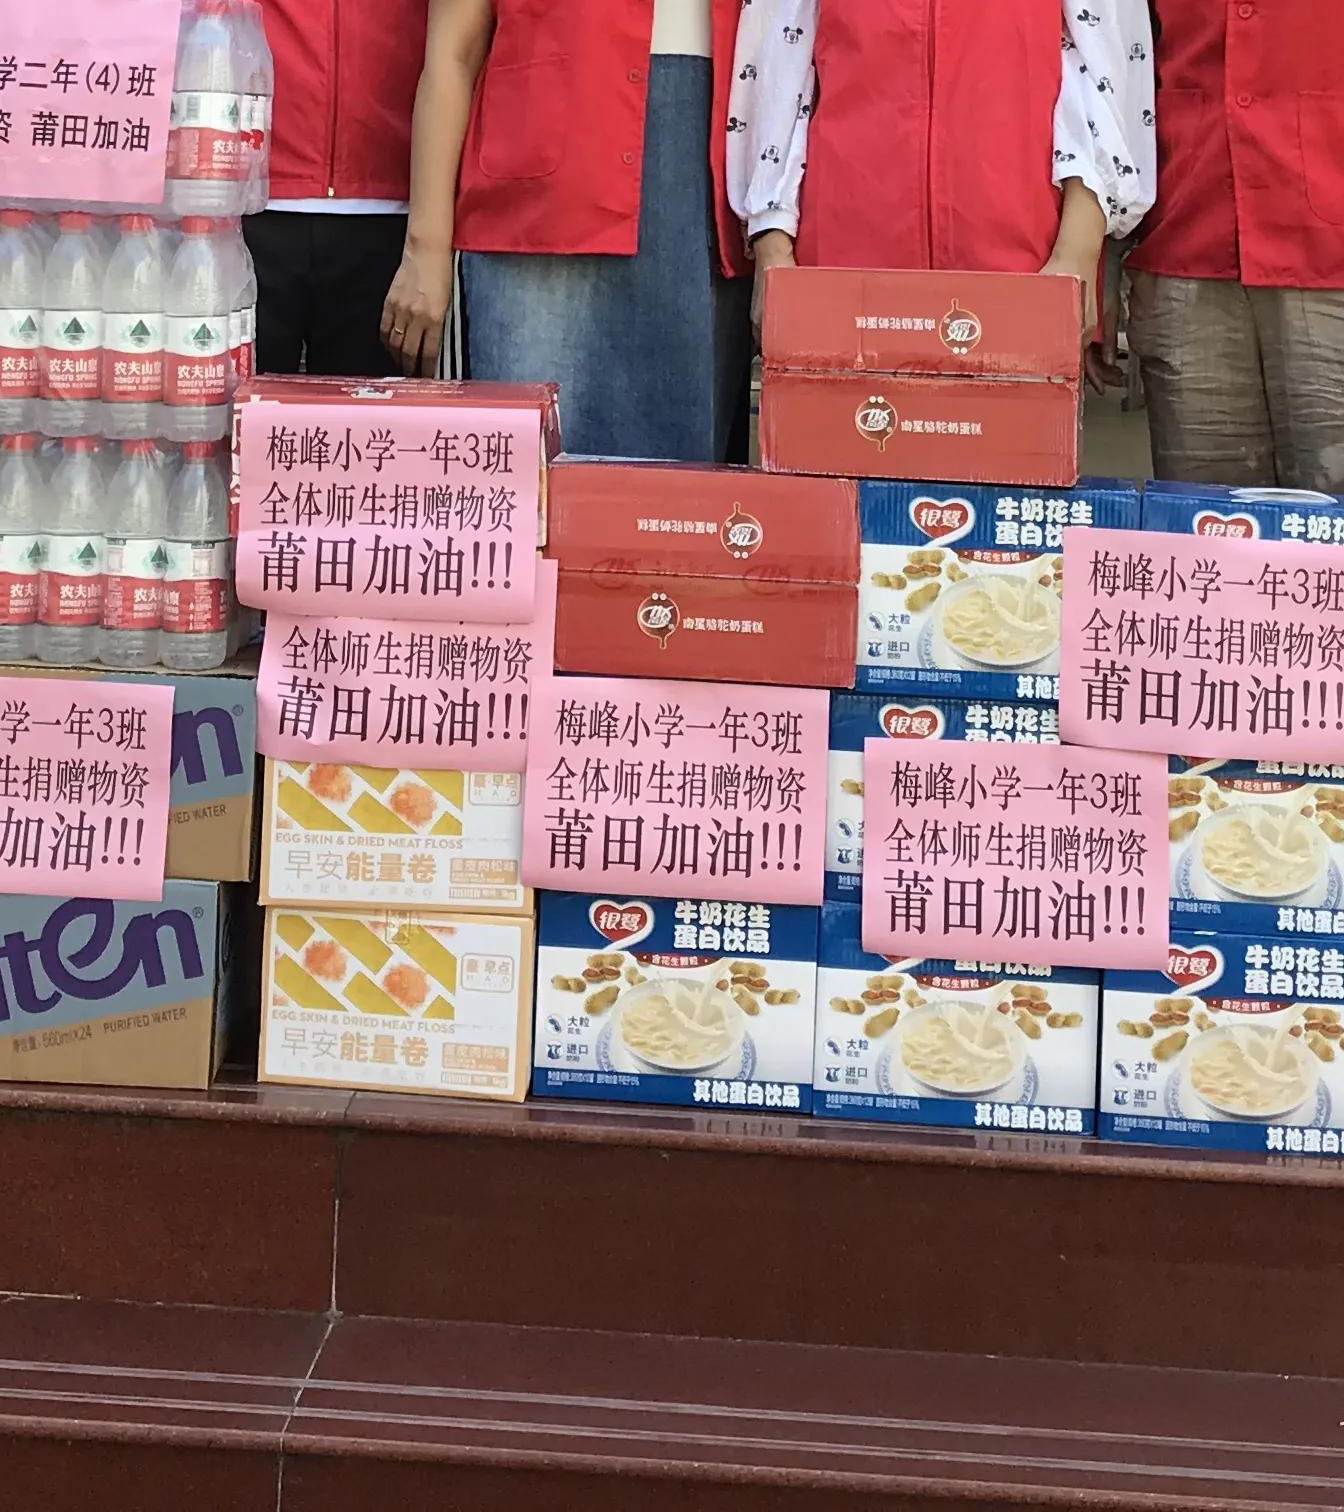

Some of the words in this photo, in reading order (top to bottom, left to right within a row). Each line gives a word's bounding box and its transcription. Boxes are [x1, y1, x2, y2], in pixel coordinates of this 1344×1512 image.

[30, 111, 151, 152] 莆田加油
[266, 426, 513, 475] 梅峰小学一年3班
[260, 481, 516, 532] 全体师生捐赠物资
[996, 497, 1093, 525] 牛奶花生
[995, 521, 1064, 548] 蛋白饮
[259, 531, 512, 597] 莆田加油!!!
[1088, 551, 1344, 613] 梅峰小学一年3班
[888, 614, 911, 625] 大粒
[282, 625, 532, 684] 全体师生捐赠物资
[887, 641, 910, 652] 进口
[278, 675, 528, 747] 莆田加油!!!
[1080, 658, 1343, 736] 莆田加油!!!
[555, 700, 803, 755] 梅峰小学一年3班
[965, 705, 1060, 732] 牛奶花生
[547, 757, 806, 813] 全体师生捐赠物资
[891, 761, 1142, 817] 梅峰小学一年3班
[276, 833, 300, 845] EGG
[304, 834, 333, 846] SKIN
[348, 836, 385, 848] DRIED
[389, 837, 422, 849] MEAT
[424, 839, 463, 850] FLOSS
[545, 807, 801, 878] 莆田加油!!!
[885, 818, 1147, 876] 全体师生捐赠物资
[285, 850, 437, 883] 早安能量卷
[674, 901, 771, 928] 牛奶花生
[884, 869, 1144, 942] 莆田加油!!!
[674, 925, 771, 954] 蛋白饮品
[1244, 944, 1344, 974] 牛奶花生
[1244, 969, 1344, 999] 蛋白饮品
[102, 1014, 151, 1035] PURIFIED
[152, 1007, 187, 1027] WATER
[272, 1011, 297, 1022] EGG
[300, 1013, 328, 1024] SKIN
[343, 1016, 378, 1029] DRIED
[381, 1018, 414, 1031] MEAT
[417, 1021, 455, 1034] FLOSS
[567, 1017, 590, 1028] 大粒
[281, 1027, 429, 1067] 早安能量卷
[567, 1044, 589, 1056] 进口
[846, 1039, 869, 1050] 大粒
[845, 1067, 868, 1078] 进口
[1134, 1061, 1157, 1073] 大粒
[694, 1080, 800, 1108] 其他蛋白饮品
[1133, 1090, 1156, 1101] 进口
[975, 1103, 1083, 1133] 其他蛋白饮品
